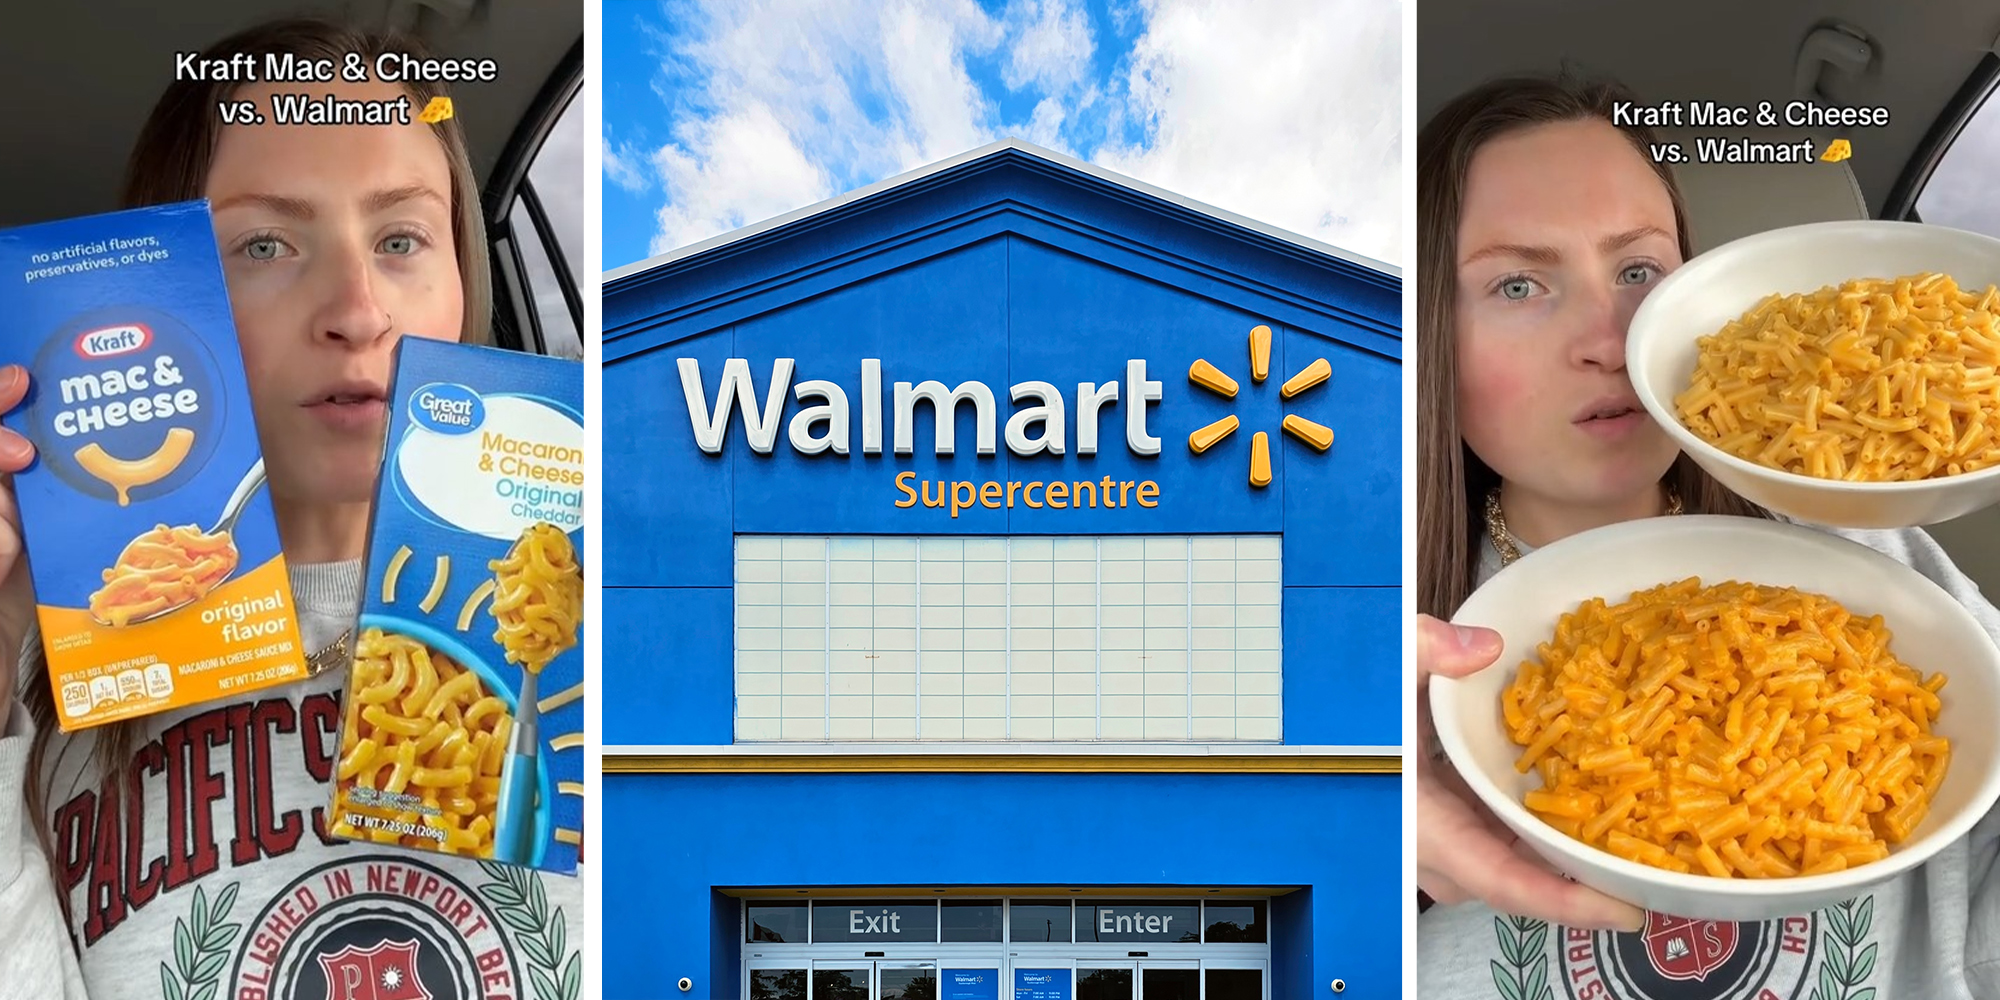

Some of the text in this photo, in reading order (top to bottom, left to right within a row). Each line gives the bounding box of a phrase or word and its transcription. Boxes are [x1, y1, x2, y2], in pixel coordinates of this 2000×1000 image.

[31, 235, 160, 264] no artificial flavors,
[25, 249, 169, 283] preservatives, or dyes
[90, 331, 137, 354] Kraft
[60, 355, 183, 404] mac &
[419, 392, 474, 416] Great
[430, 409, 471, 427] Value
[676, 356, 1163, 457] Walmart
[482, 431, 584, 465] Macaron
[478, 453, 584, 486] & Cheese
[496, 478, 583, 508] Original
[894, 470, 1161, 519] Supercentre
[511, 502, 582, 526] Cheddar
[201, 589, 285, 624] original
[221, 617, 287, 644] flavor
[178, 641, 293, 675] MACARONI & CHEESE SAUCE MIX
[64, 684, 87, 701] 250
[218, 677, 234, 690] NET
[234, 674, 249, 686] WT
[54, 696, 304, 948] PACIFIC
[345, 813, 447, 842] NET WT 7.25 OZ (206g)
[323, 868, 353, 900] IN
[367, 864, 488, 939] NEWPORT
[848, 908, 901, 935] Exit
[1099, 908, 1173, 935] Enter
